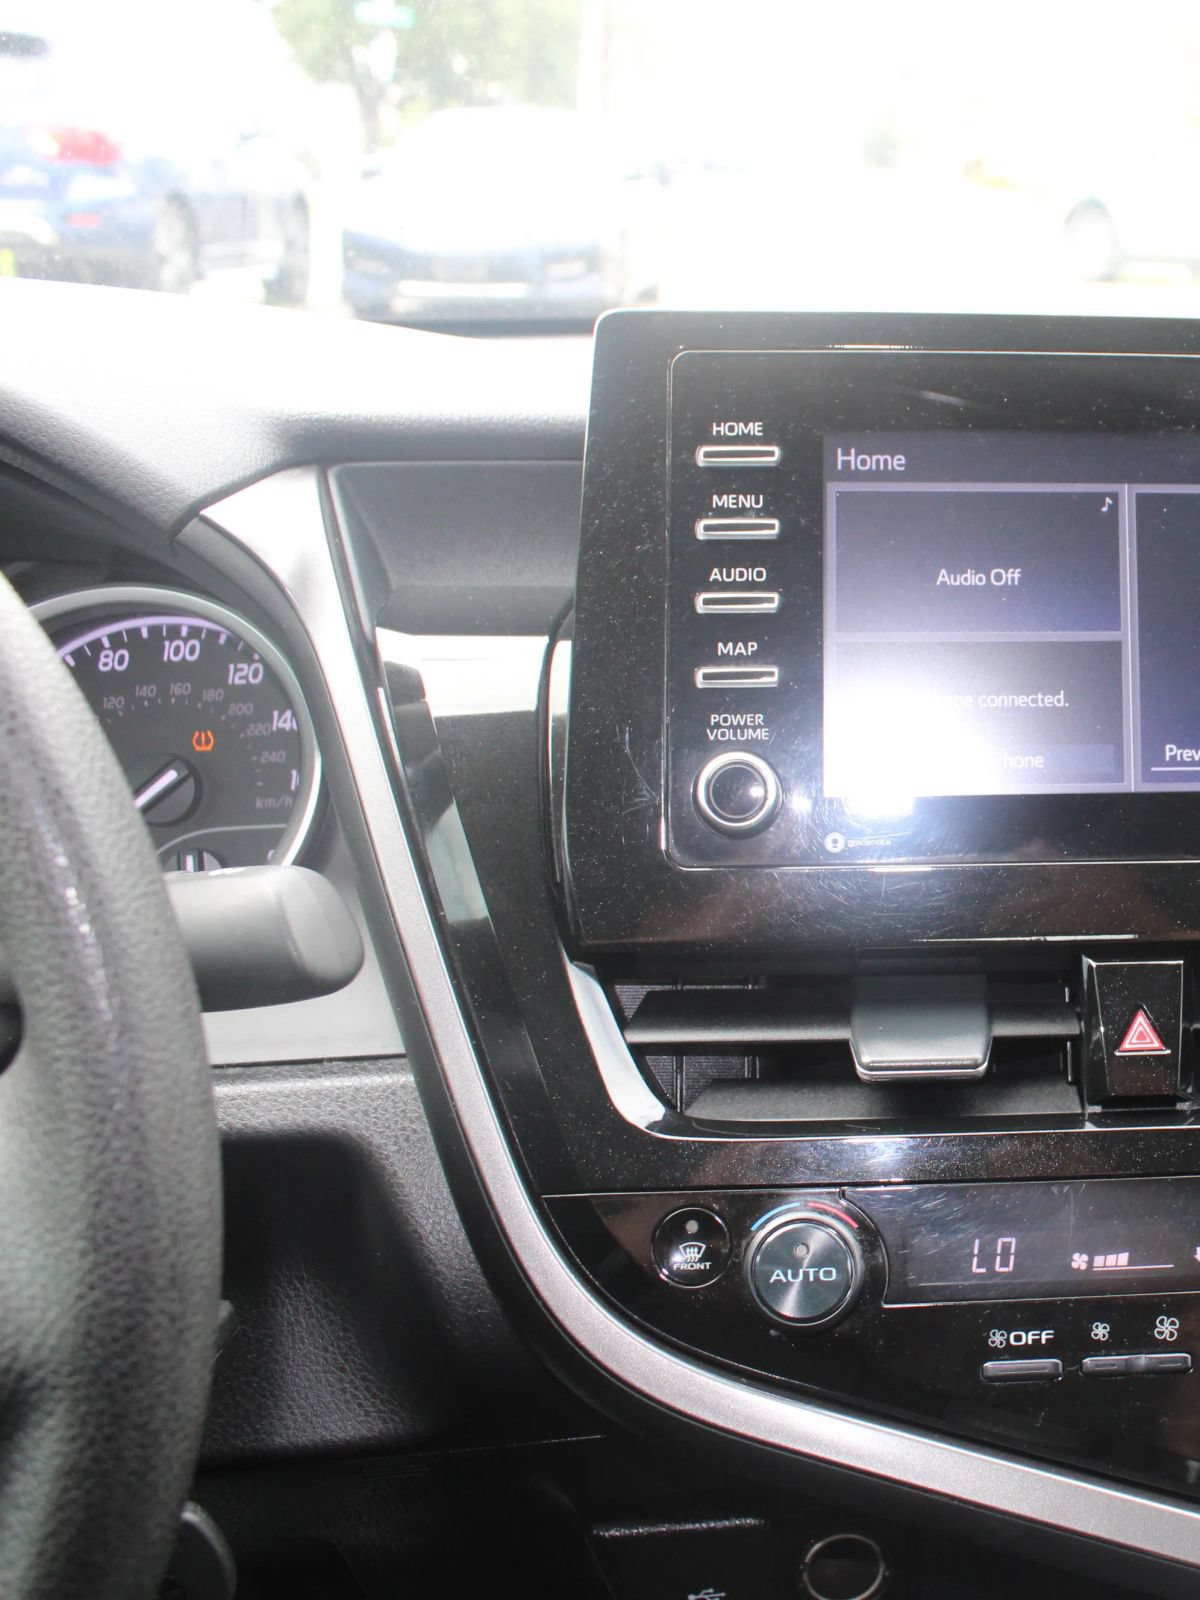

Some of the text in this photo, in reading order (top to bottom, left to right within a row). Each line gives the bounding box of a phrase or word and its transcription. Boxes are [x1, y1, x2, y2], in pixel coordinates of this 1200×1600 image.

[713, 422, 763, 436] HOME
[837, 448, 905, 471] Home
[713, 495, 763, 508] MENU
[710, 568, 767, 581] AUDIO
[937, 568, 1021, 586] Audio Off
[163, 640, 200, 662] 100
[717, 642, 757, 656] MAP
[98, 650, 129, 672] 80
[228, 663, 263, 685] 120
[135, 684, 156, 698] 140
[170, 682, 191, 696] 160
[202, 688, 224, 702] 180
[103, 697, 125, 709] 120
[978, 691, 1069, 707] connected.
[228, 702, 253, 716] 200
[710, 714, 764, 726] POWER
[707, 728, 769, 740] VOLUME
[260, 751, 286, 763] 240
[673, 1261, 711, 1270] FRONT
[769, 1267, 836, 1284] AUTO
[1010, 1330, 1054, 1346] OFF
